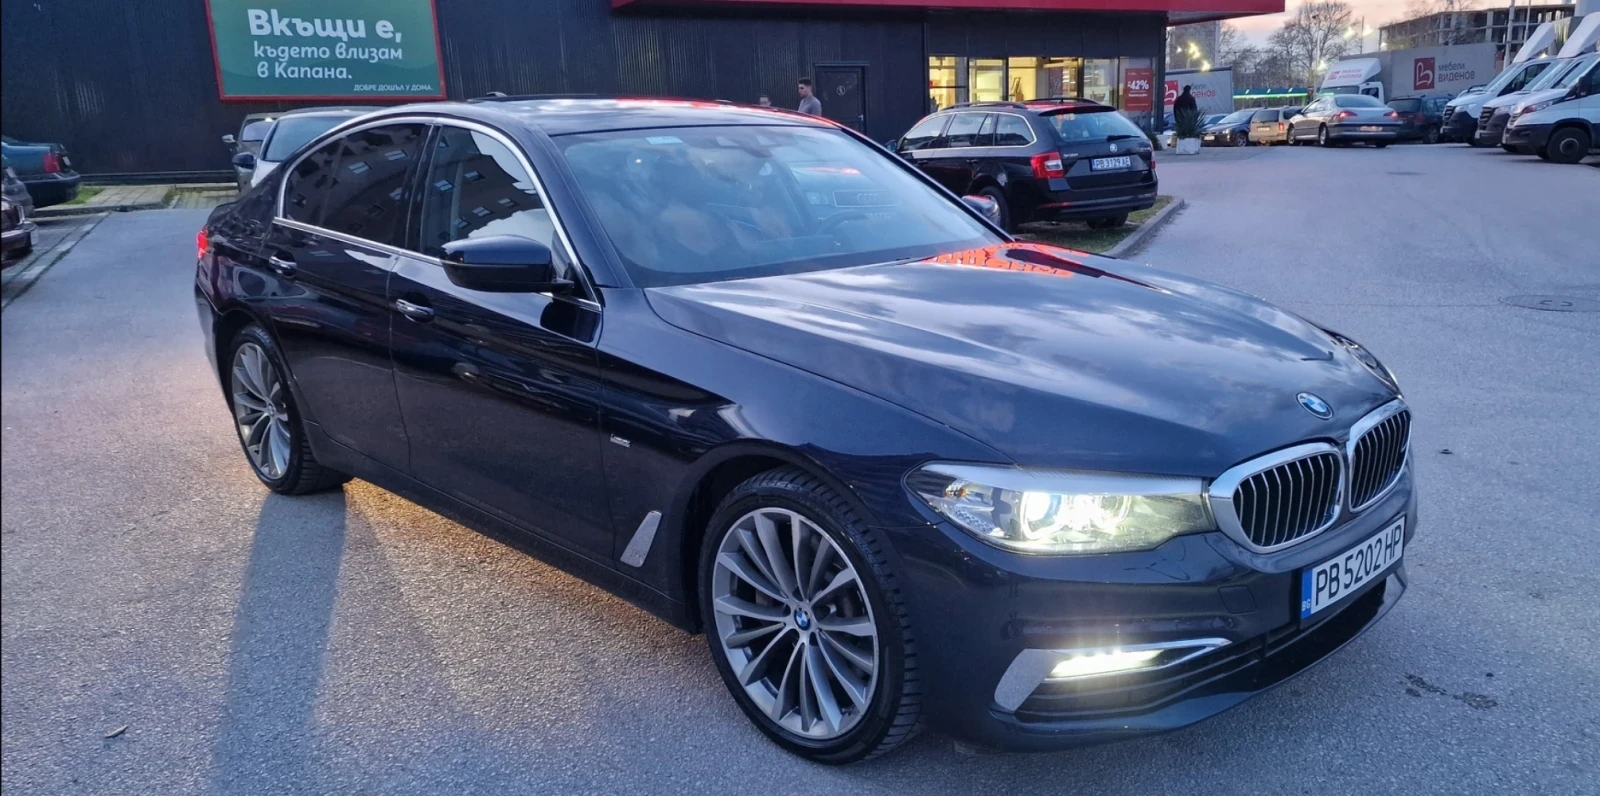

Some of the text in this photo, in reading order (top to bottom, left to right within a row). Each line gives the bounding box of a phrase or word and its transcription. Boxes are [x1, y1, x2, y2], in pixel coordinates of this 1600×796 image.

[247, 8, 402, 43] Вкъщи е,
[253, 41, 403, 64] където влизам
[257, 61, 353, 79] в Капана.
[1438, 61, 1466, 72] мебели
[353, 84, 378, 92] ДОБРЕ
[378, 84, 405, 92] ДОШЪЛ
[411, 84, 434, 92] ДОМА.
[1315, 525, 1403, 606] PB 5202 HP
[1301, 599, 1312, 611] BG
